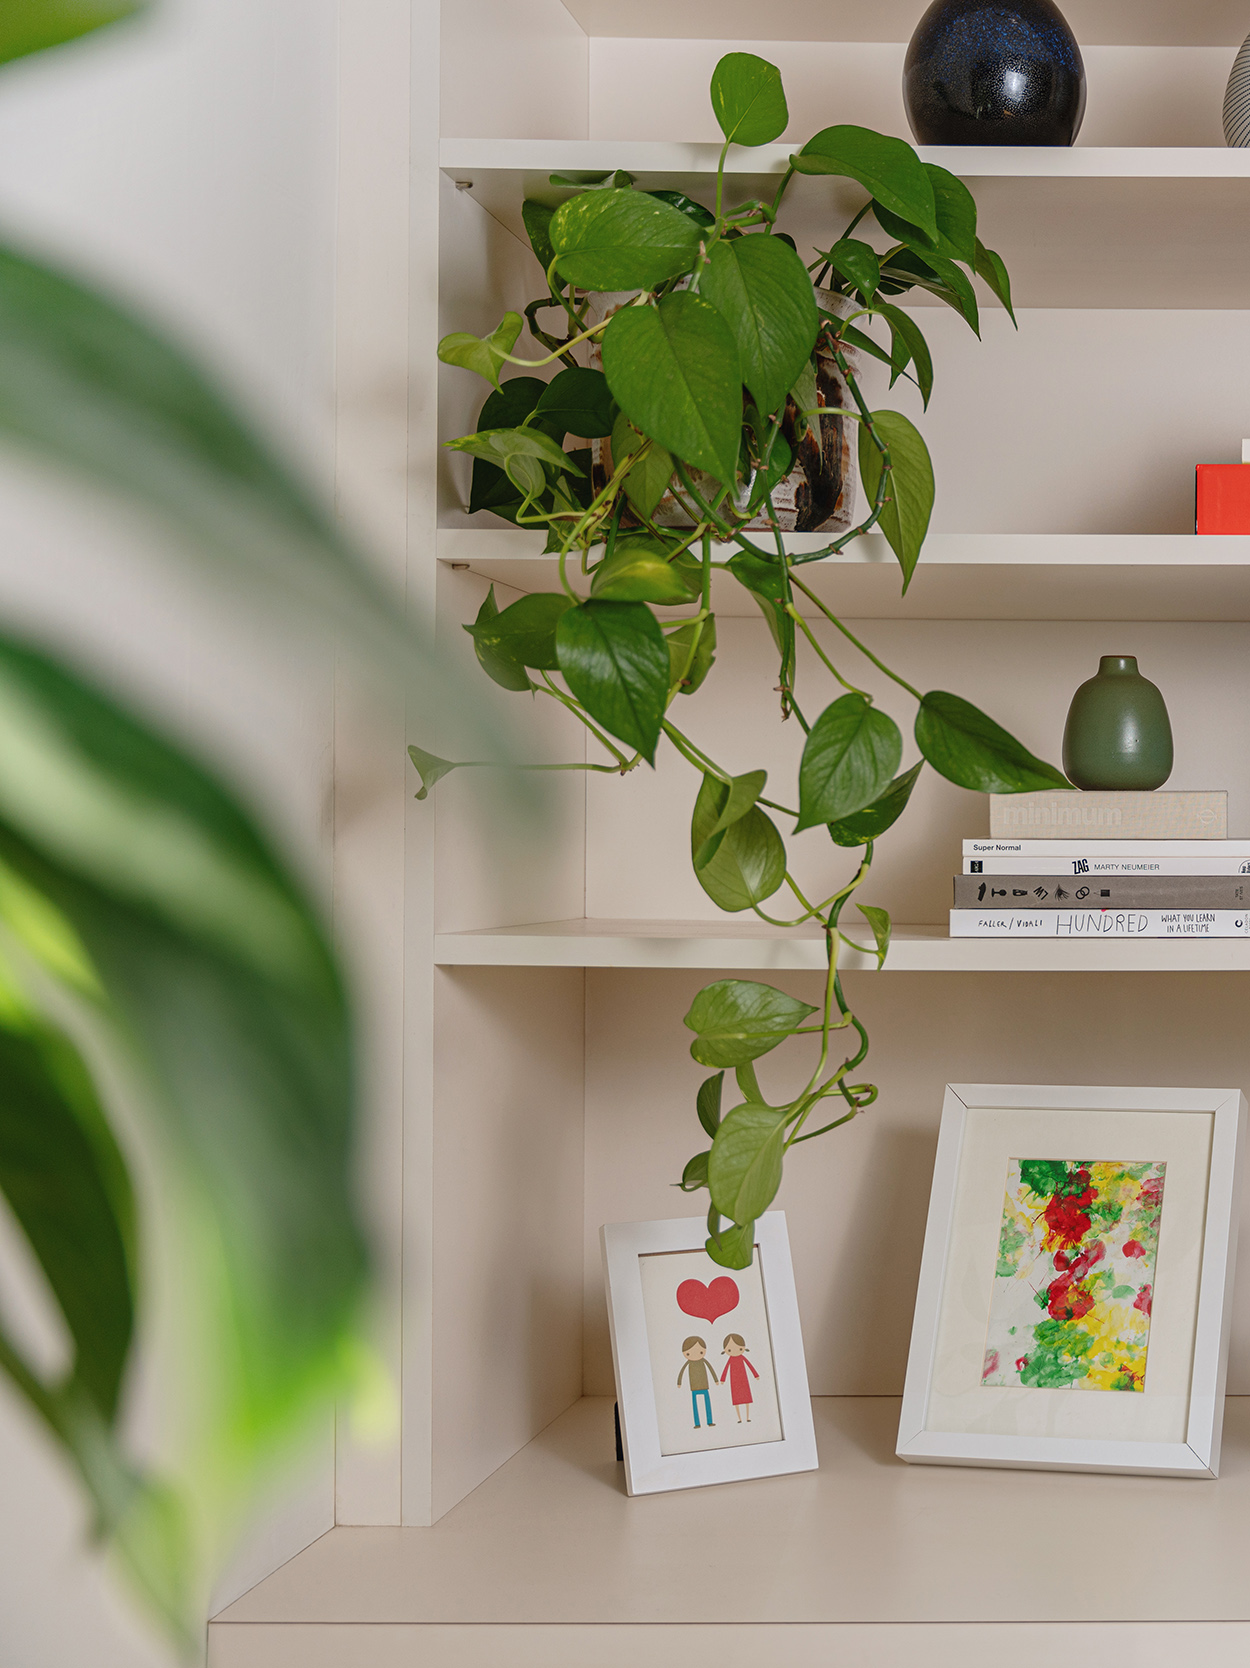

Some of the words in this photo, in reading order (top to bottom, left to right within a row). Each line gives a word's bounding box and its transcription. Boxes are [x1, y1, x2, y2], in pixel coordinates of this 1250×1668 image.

[1004, 803, 1122, 827] minimum
[973, 844, 993, 853] Super
[996, 844, 1021, 852] Normal
[1072, 858, 1089, 875] ZAG
[1056, 914, 1149, 935] HUNDRED
[1161, 915, 1181, 923] WHAT
[1183, 914, 1195, 923] YOU
[1196, 914, 1216, 922] LEARN
[1176, 925, 1182, 933] A
[1183, 924, 1210, 932] LIFETIME
